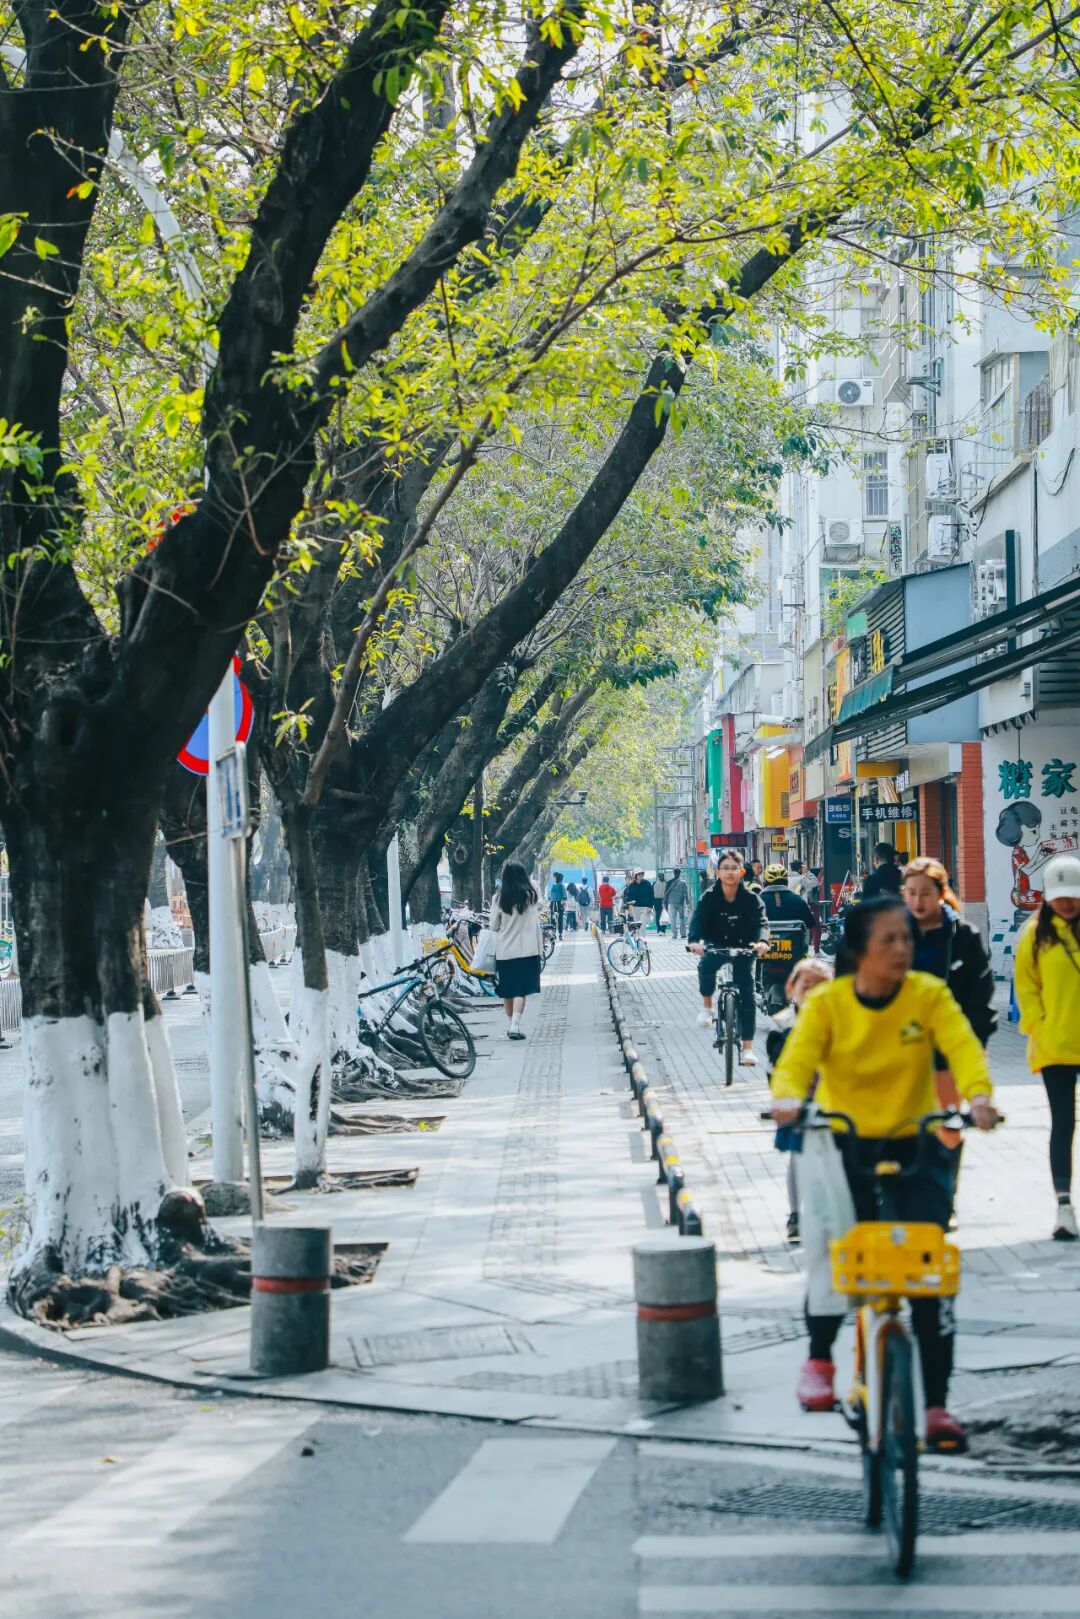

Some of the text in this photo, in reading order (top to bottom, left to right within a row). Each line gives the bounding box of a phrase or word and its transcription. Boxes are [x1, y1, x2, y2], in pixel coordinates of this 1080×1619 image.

[998, 759, 1078, 799] 糖家
[828, 804, 850, 812] 365
[861, 805, 913, 820] 手机维修
